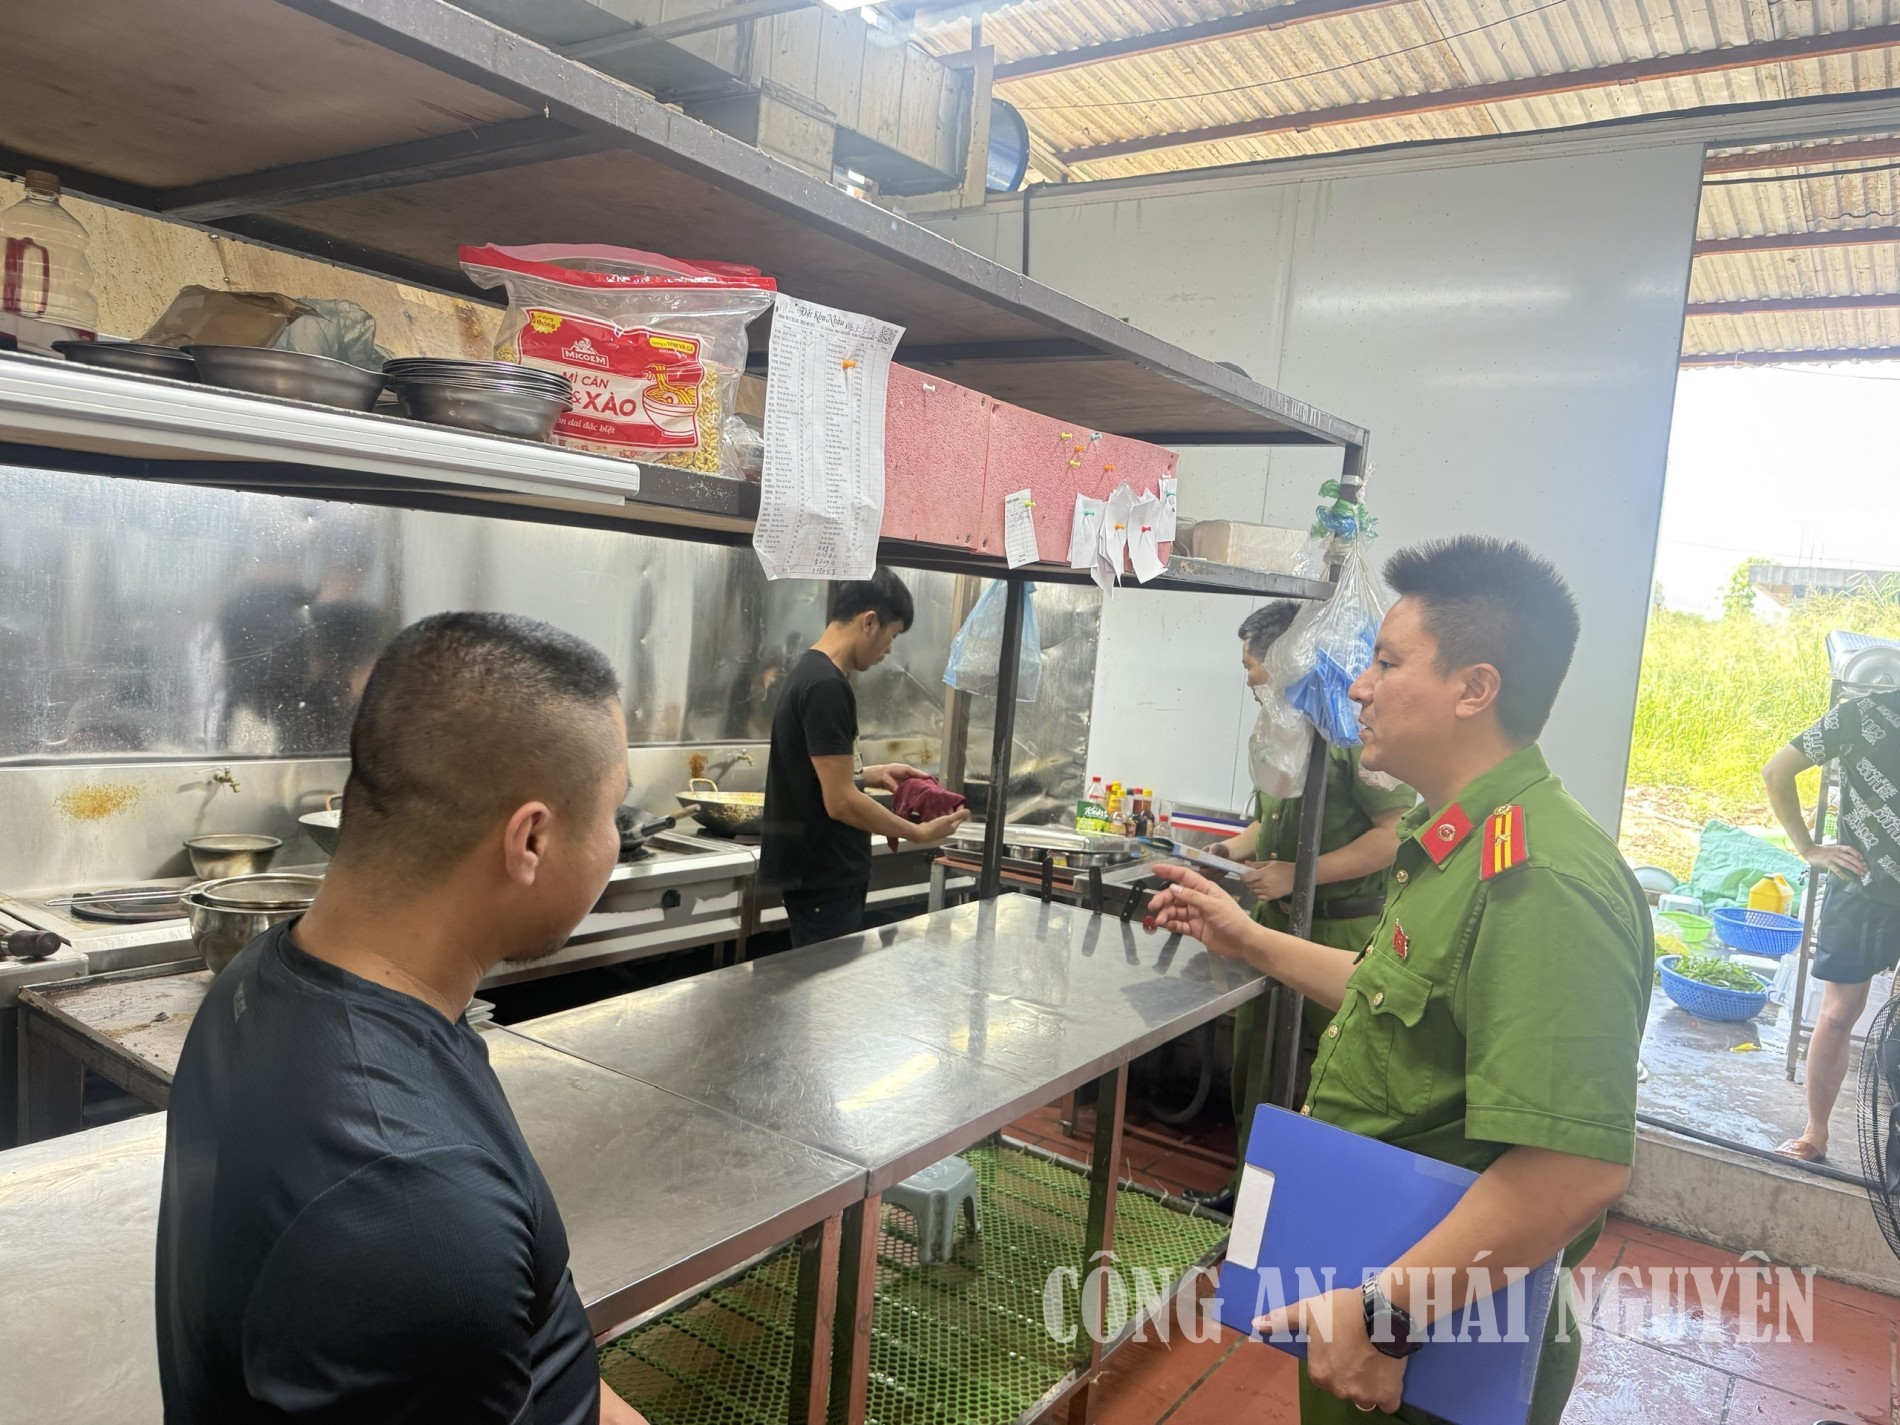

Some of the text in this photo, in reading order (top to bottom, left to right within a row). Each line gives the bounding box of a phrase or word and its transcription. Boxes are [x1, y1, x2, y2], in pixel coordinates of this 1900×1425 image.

[565, 350, 606, 365] MICOEM
[563, 371, 578, 384] MÌ
[582, 390, 637, 417] XÀO
[568, 418, 582, 428] dai
[583, 421, 599, 432] đặc
[599, 424, 616, 435] biệt
[1856, 760, 1893, 801] COUTURE
